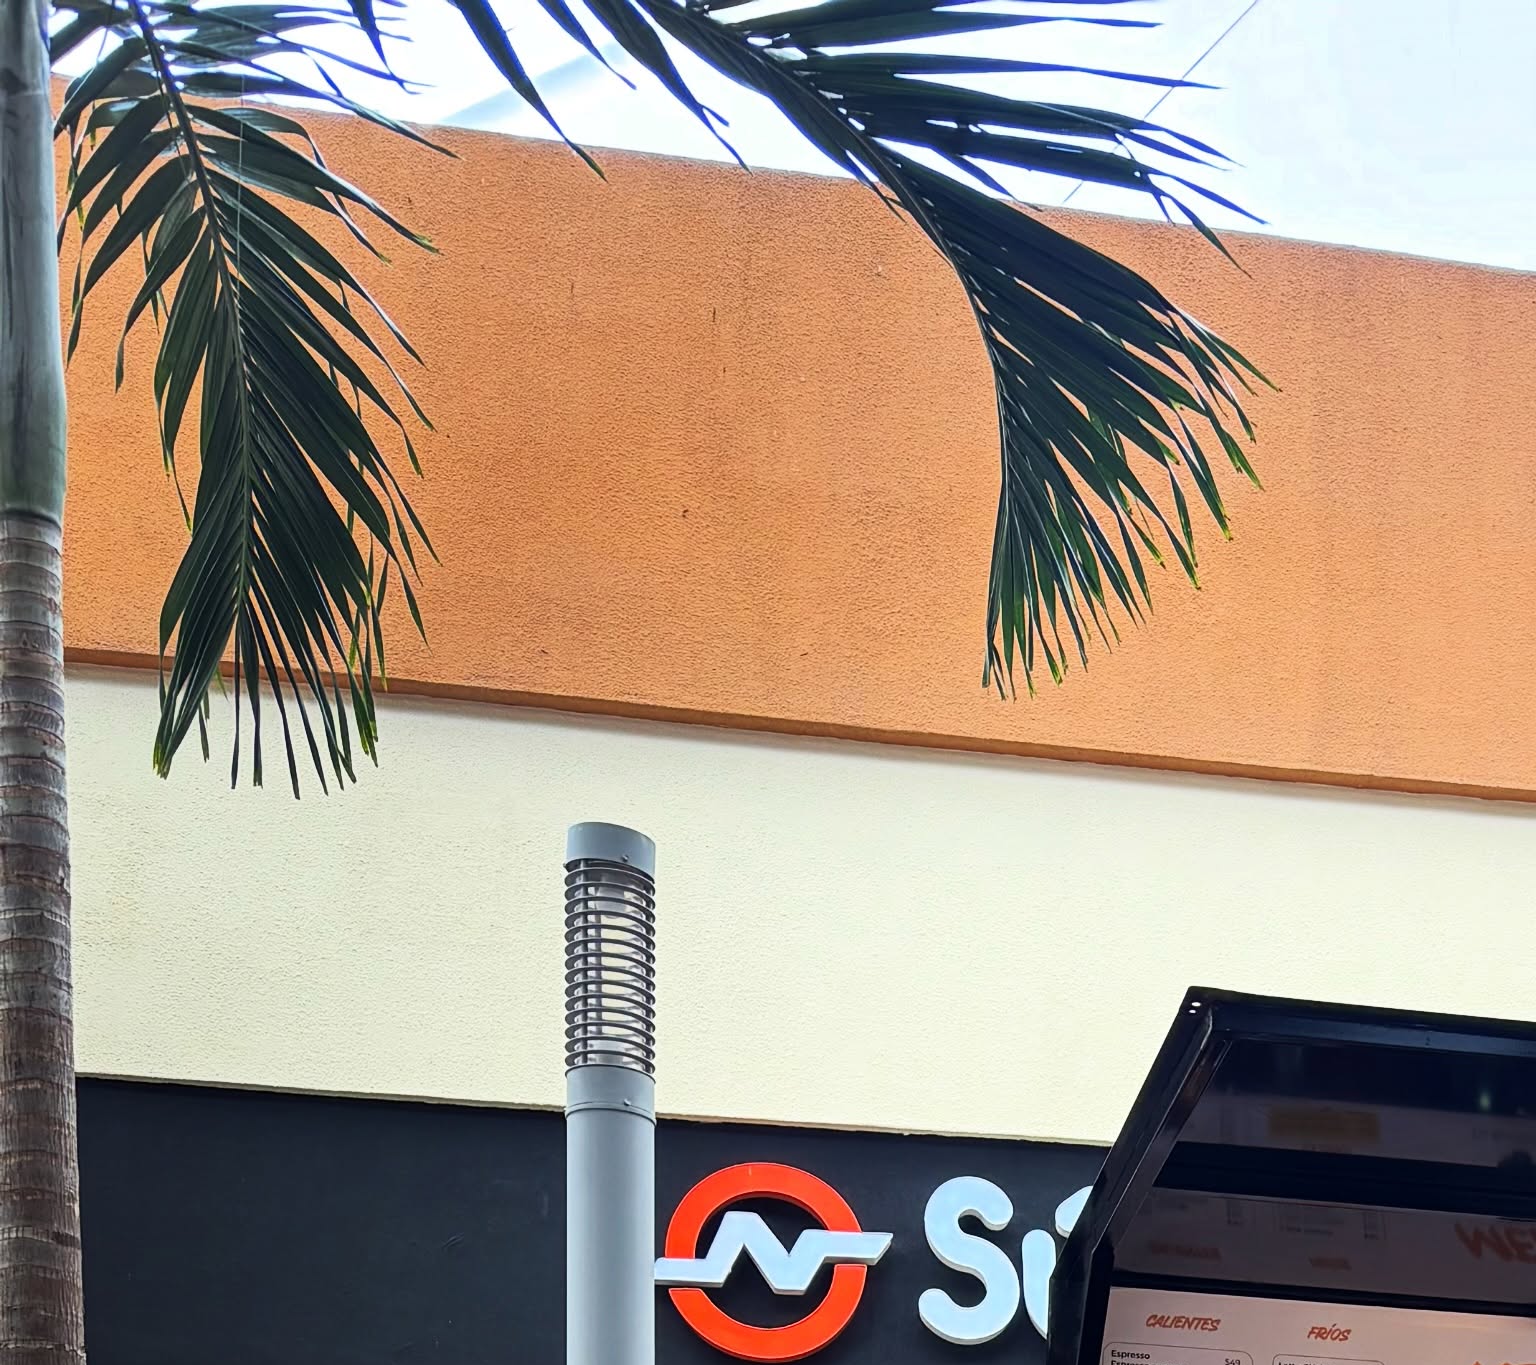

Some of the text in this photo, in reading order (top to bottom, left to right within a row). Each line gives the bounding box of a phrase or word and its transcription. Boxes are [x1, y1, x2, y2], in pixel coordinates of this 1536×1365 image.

[1146, 1314, 1221, 1331] CALIENTES
[1307, 1323, 1351, 1341] FRÍOS
[1111, 1350, 1150, 1359] Espresso
